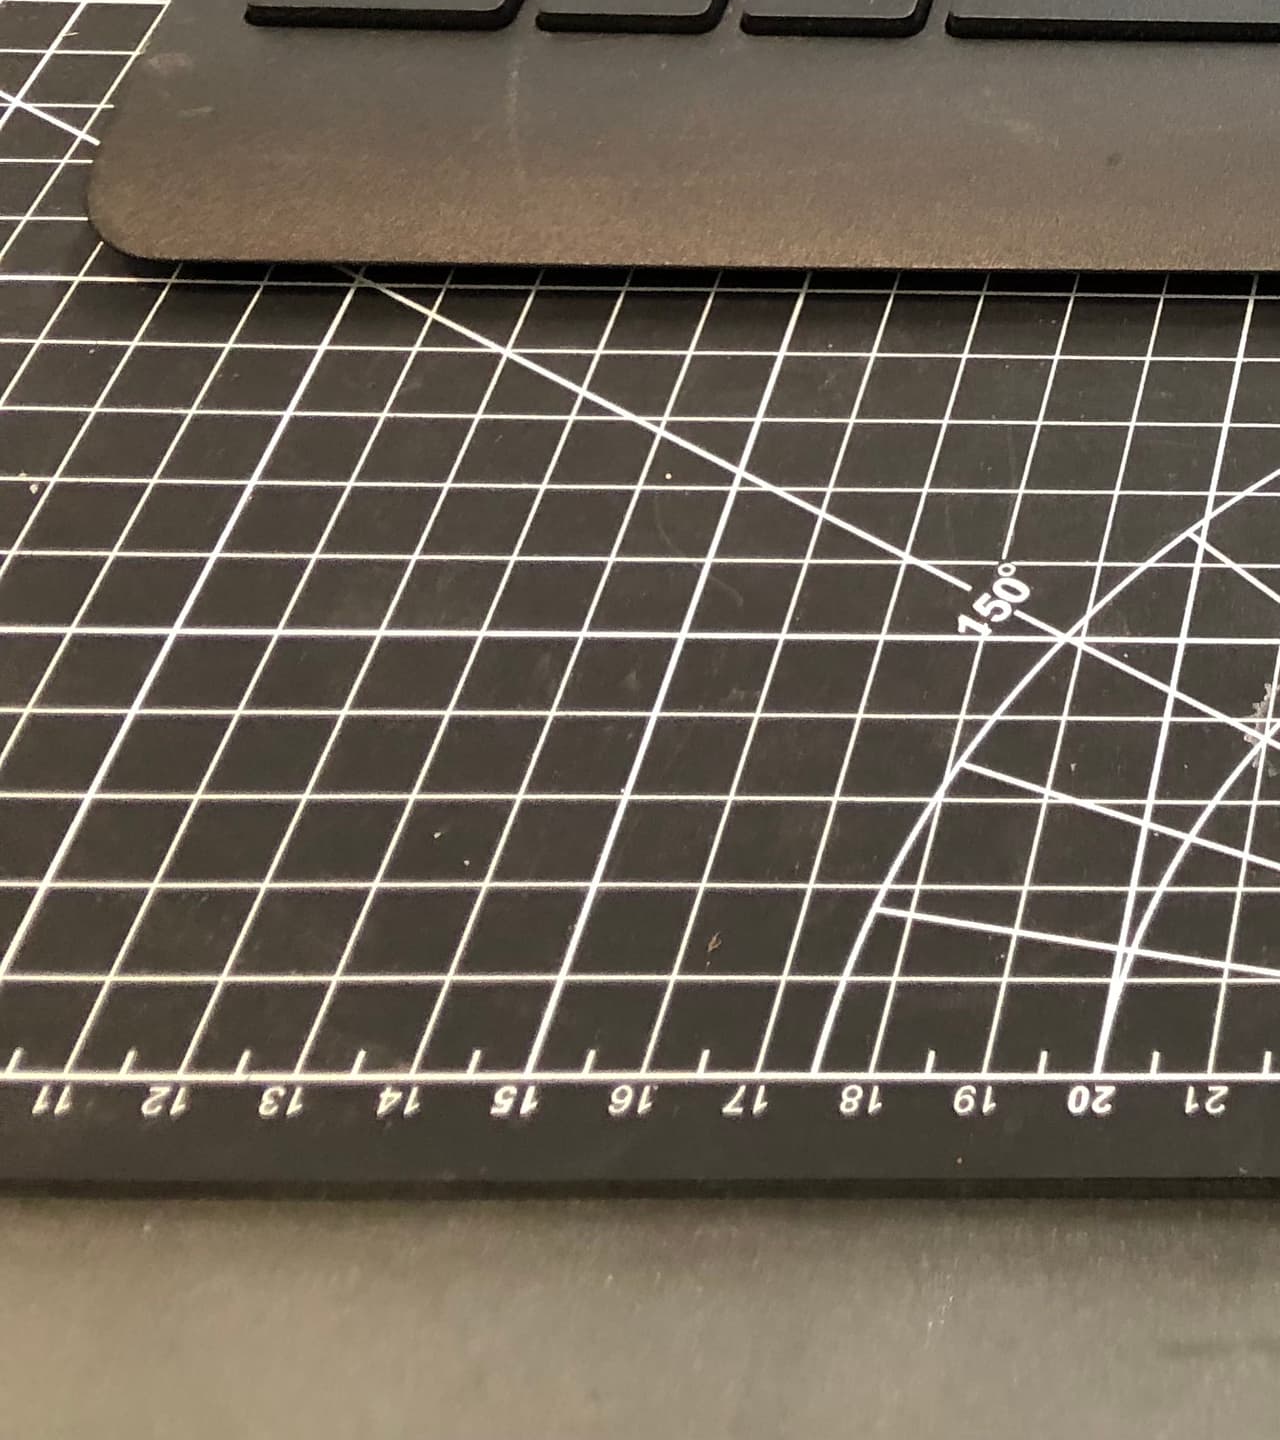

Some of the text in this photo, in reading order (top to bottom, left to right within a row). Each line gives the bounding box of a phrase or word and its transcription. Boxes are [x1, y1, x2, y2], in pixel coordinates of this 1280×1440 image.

[956, 562, 1031, 638] 150°
[32, 1086, 71, 1115] 11
[141, 1086, 187, 1117] 12
[259, 1086, 303, 1116] 13
[377, 1086, 420, 1116] 14
[490, 1086, 538, 1116] 15
[608, 1086, 652, 1116] 16
[722, 1086, 768, 1115] 17
[839, 1086, 882, 1115] 18
[953, 1086, 996, 1115] 19
[1067, 1086, 1116, 1114] 20
[1185, 1086, 1229, 1114] 21
